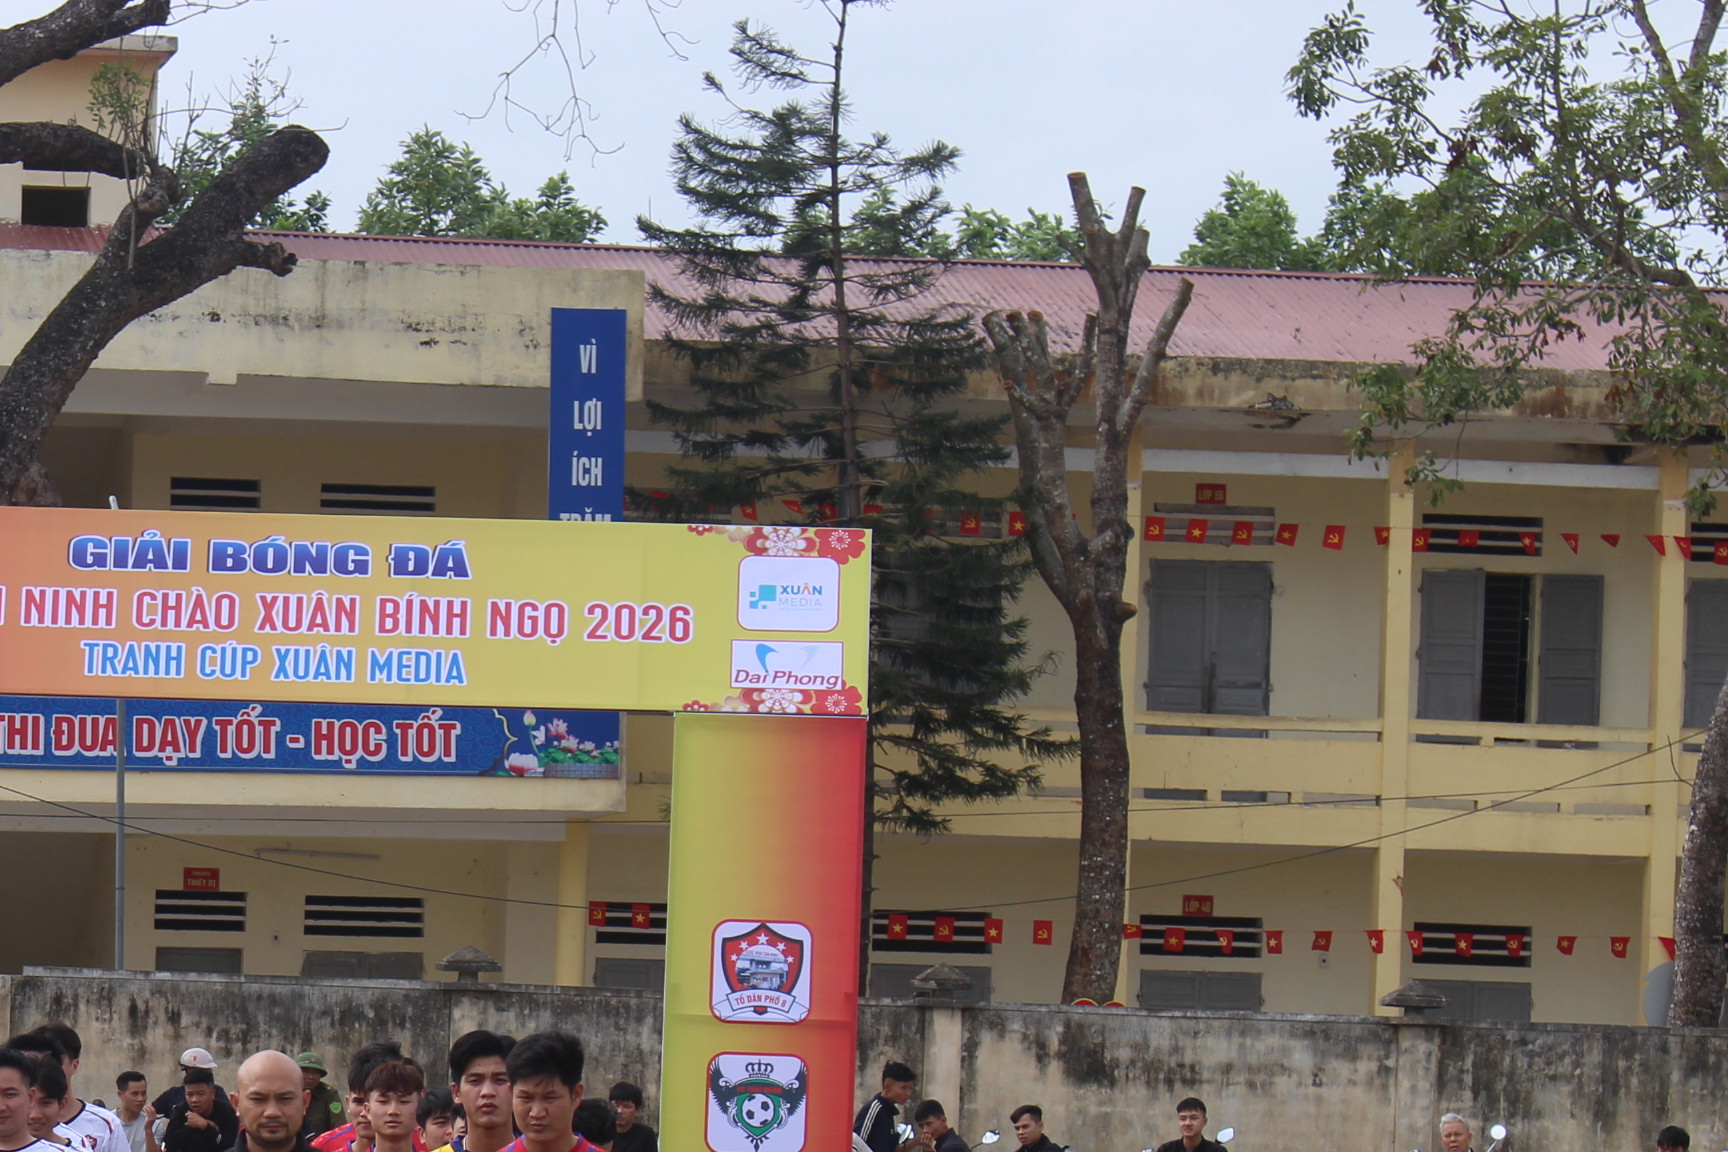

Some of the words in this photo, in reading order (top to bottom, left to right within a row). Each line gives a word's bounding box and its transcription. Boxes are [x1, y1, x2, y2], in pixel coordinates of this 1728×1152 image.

[579, 338, 597, 374] VÌ
[573, 398, 602, 437] LỢI
[571, 450, 603, 487] ÍCH
[69, 529, 191, 573] GIẢI
[208, 534, 372, 577] BÓNG
[388, 539, 472, 579] ĐÁ
[779, 598, 822, 607] MEDIA
[780, 582, 823, 596] XUÂN
[20, 586, 116, 630] NINH
[133, 587, 239, 633] CHÀO
[254, 590, 360, 637] XUÂN
[375, 591, 470, 639] BÍNH
[487, 599, 568, 646] NGỌ
[583, 602, 694, 644] 2026
[80, 639, 184, 679] TRANH
[197, 640, 260, 681] CÚP
[272, 642, 356, 684] XUÂN
[368, 647, 468, 687] MEDIA
[771, 670, 840, 689] Phong
[50, 712, 124, 757] ĐUA
[133, 715, 207, 766] DẠY
[213, 704, 280, 759] TỐT
[310, 716, 389, 769] HỌC
[393, 709, 460, 764] TỐT
[781, 999, 787, 1007] 8
